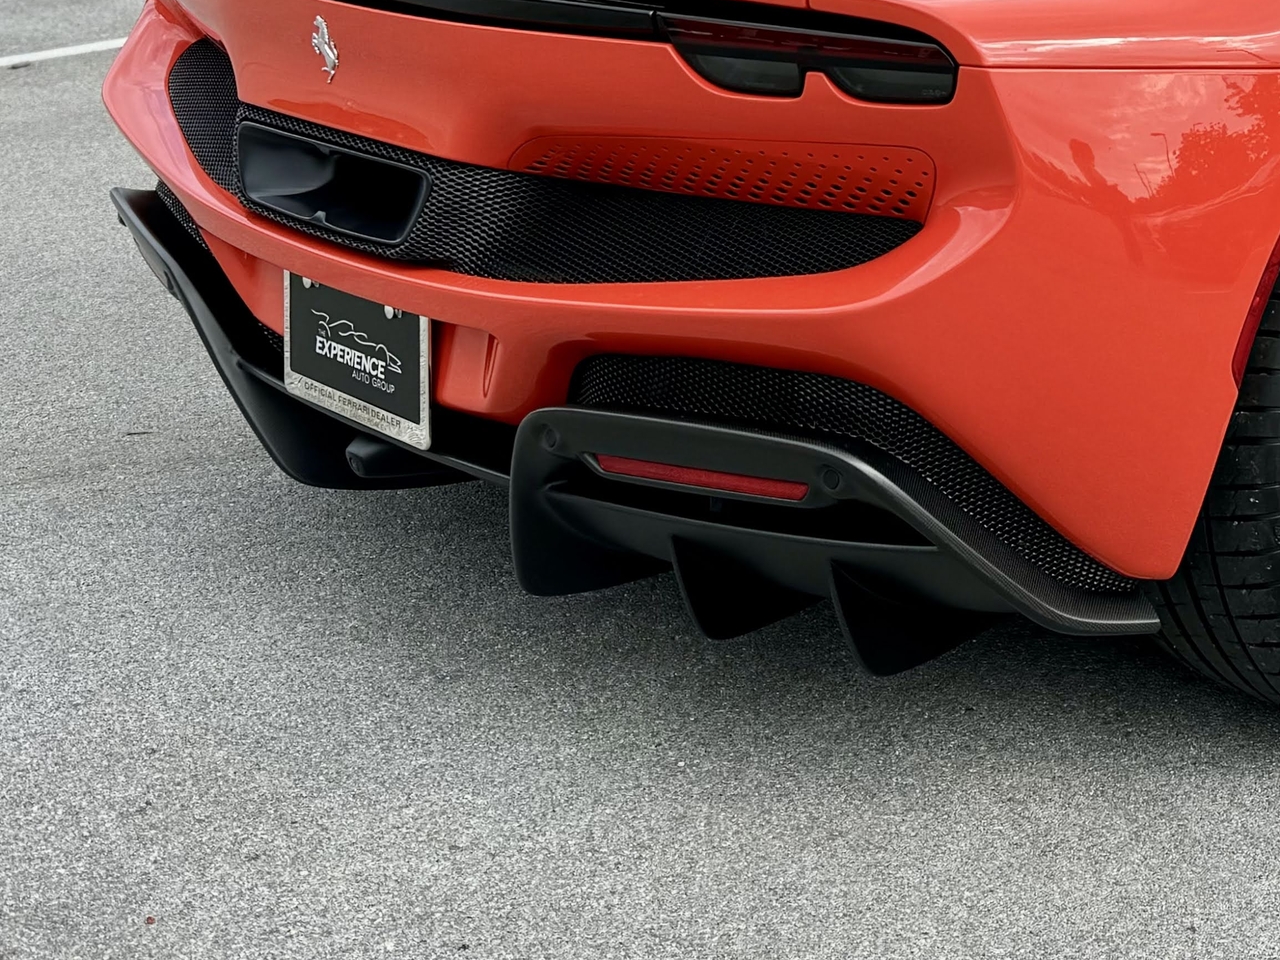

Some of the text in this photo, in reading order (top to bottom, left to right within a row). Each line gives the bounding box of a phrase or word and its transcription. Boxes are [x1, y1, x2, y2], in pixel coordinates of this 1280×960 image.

[315, 335, 386, 379] EXPERIENCE
[352, 370, 395, 394] AUTO GROUP
[304, 381, 337, 402] OFFICIAL
[338, 395, 370, 415] FERRARI
[371, 409, 401, 428] DEALER
